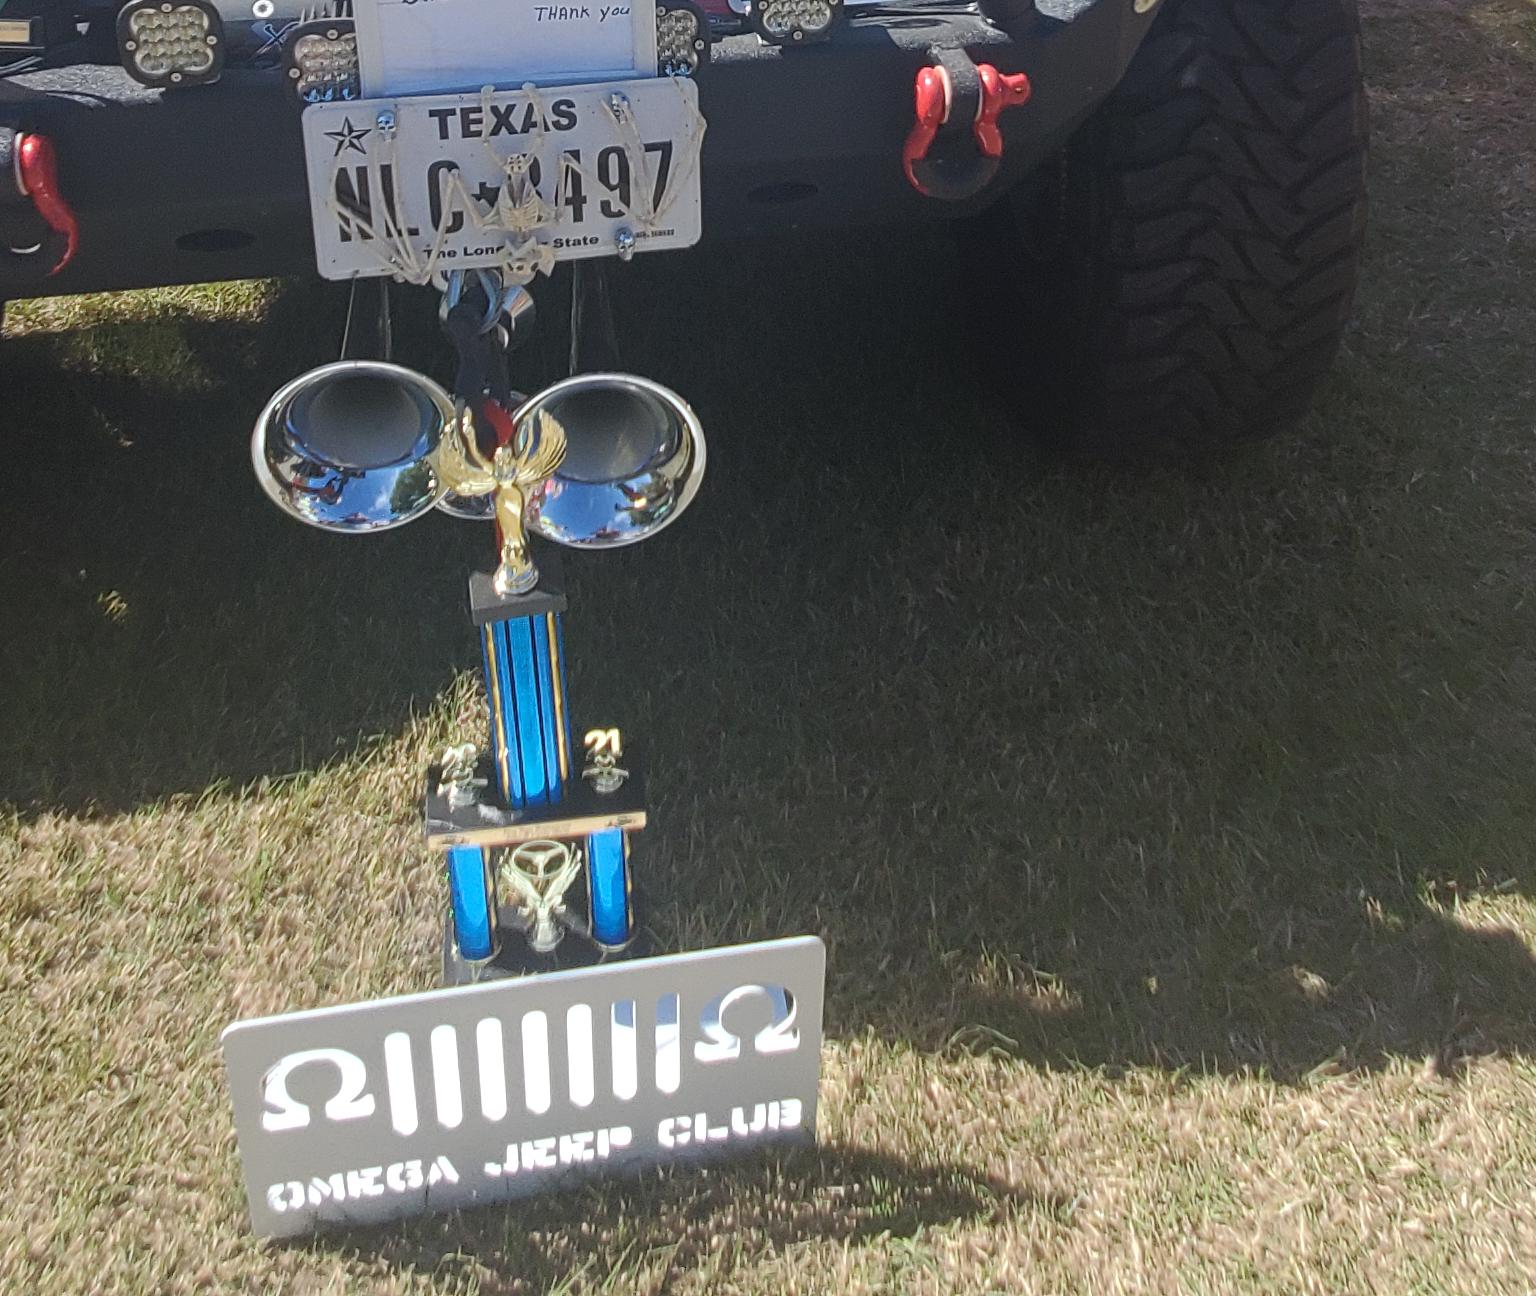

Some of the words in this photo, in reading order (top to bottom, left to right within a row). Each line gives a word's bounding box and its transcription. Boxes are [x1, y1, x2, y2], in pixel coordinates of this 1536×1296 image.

[428, 99, 578, 140] TEXAS
[424, 248, 457, 260] The
[553, 236, 599, 249] State
[267, 1156, 460, 1213] OMEGA
[483, 1125, 634, 1177] JEEP
[658, 1098, 802, 1149] CLUB
